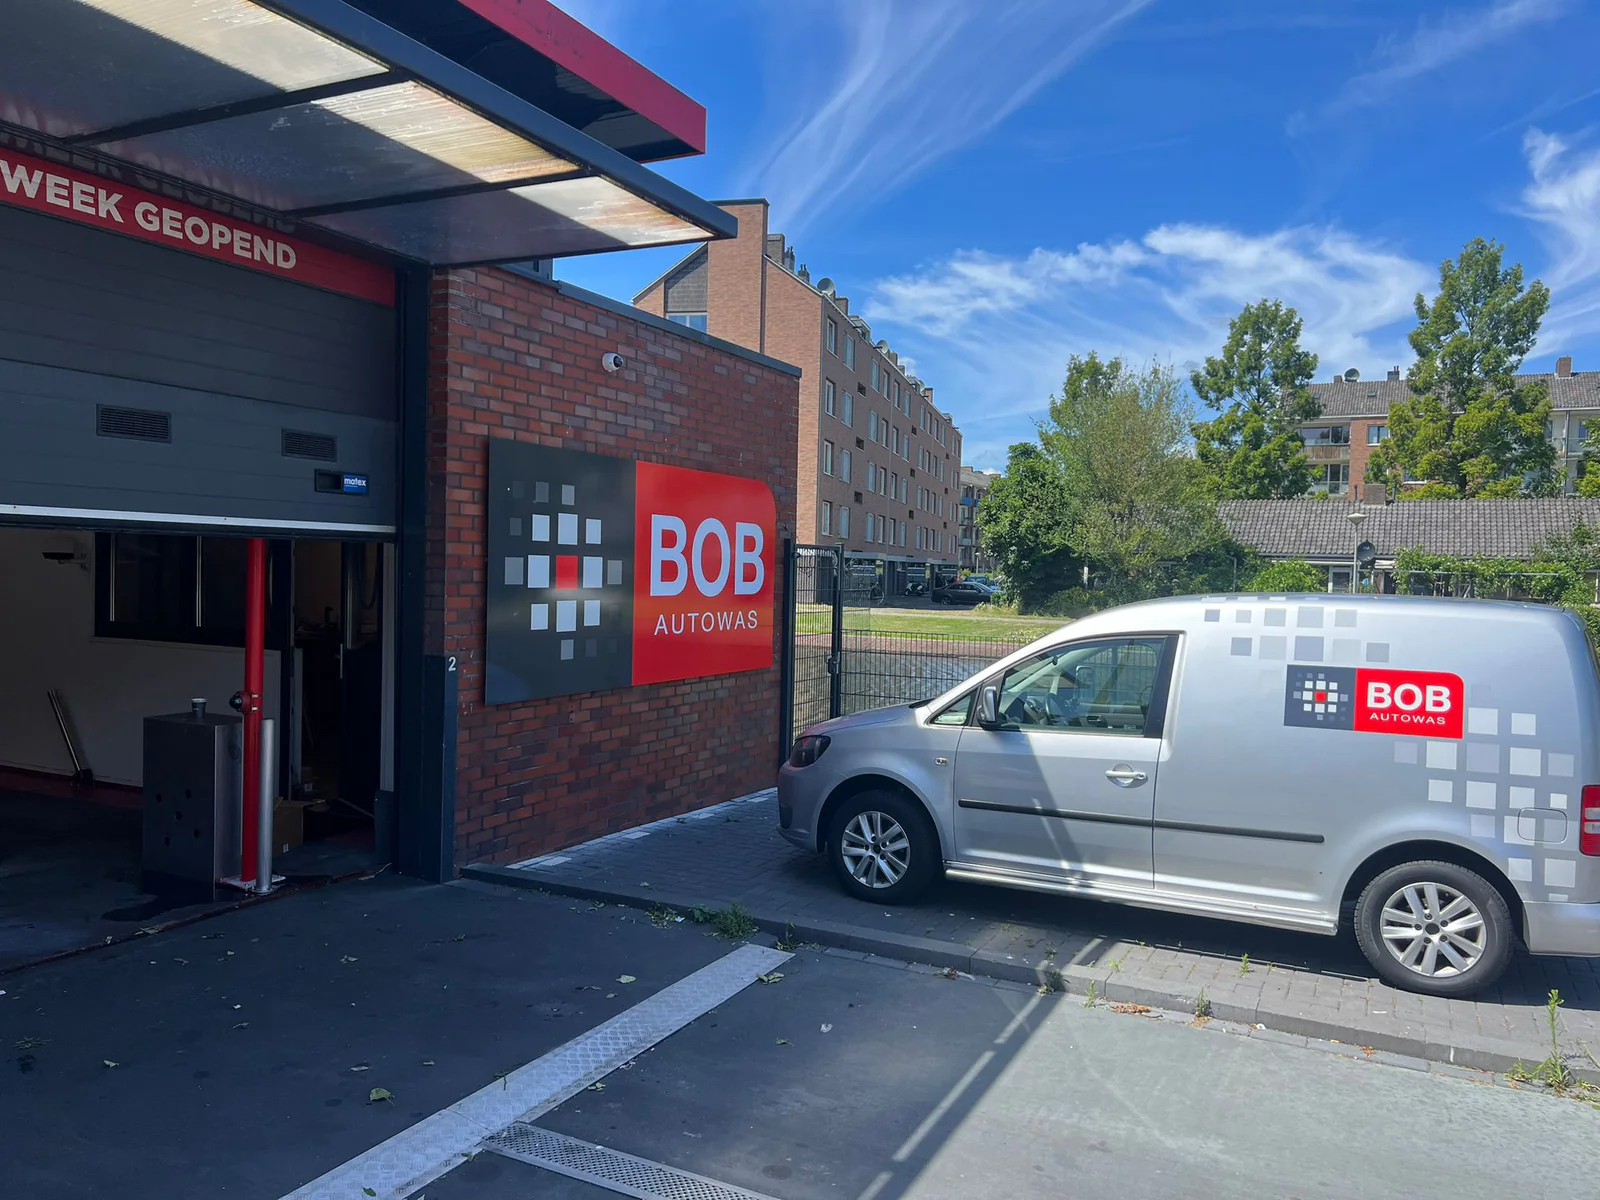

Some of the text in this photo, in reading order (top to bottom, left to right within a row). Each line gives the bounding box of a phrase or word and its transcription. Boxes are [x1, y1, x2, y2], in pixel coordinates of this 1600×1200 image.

[0, 159, 296, 269] WEEK GEOPEND
[650, 514, 765, 598] BOB
[654, 610, 759, 636] AUTOWAS
[448, 656, 457, 672] 2
[1367, 681, 1452, 712] BOB
[1369, 712, 1446, 724] AUTOWAS
